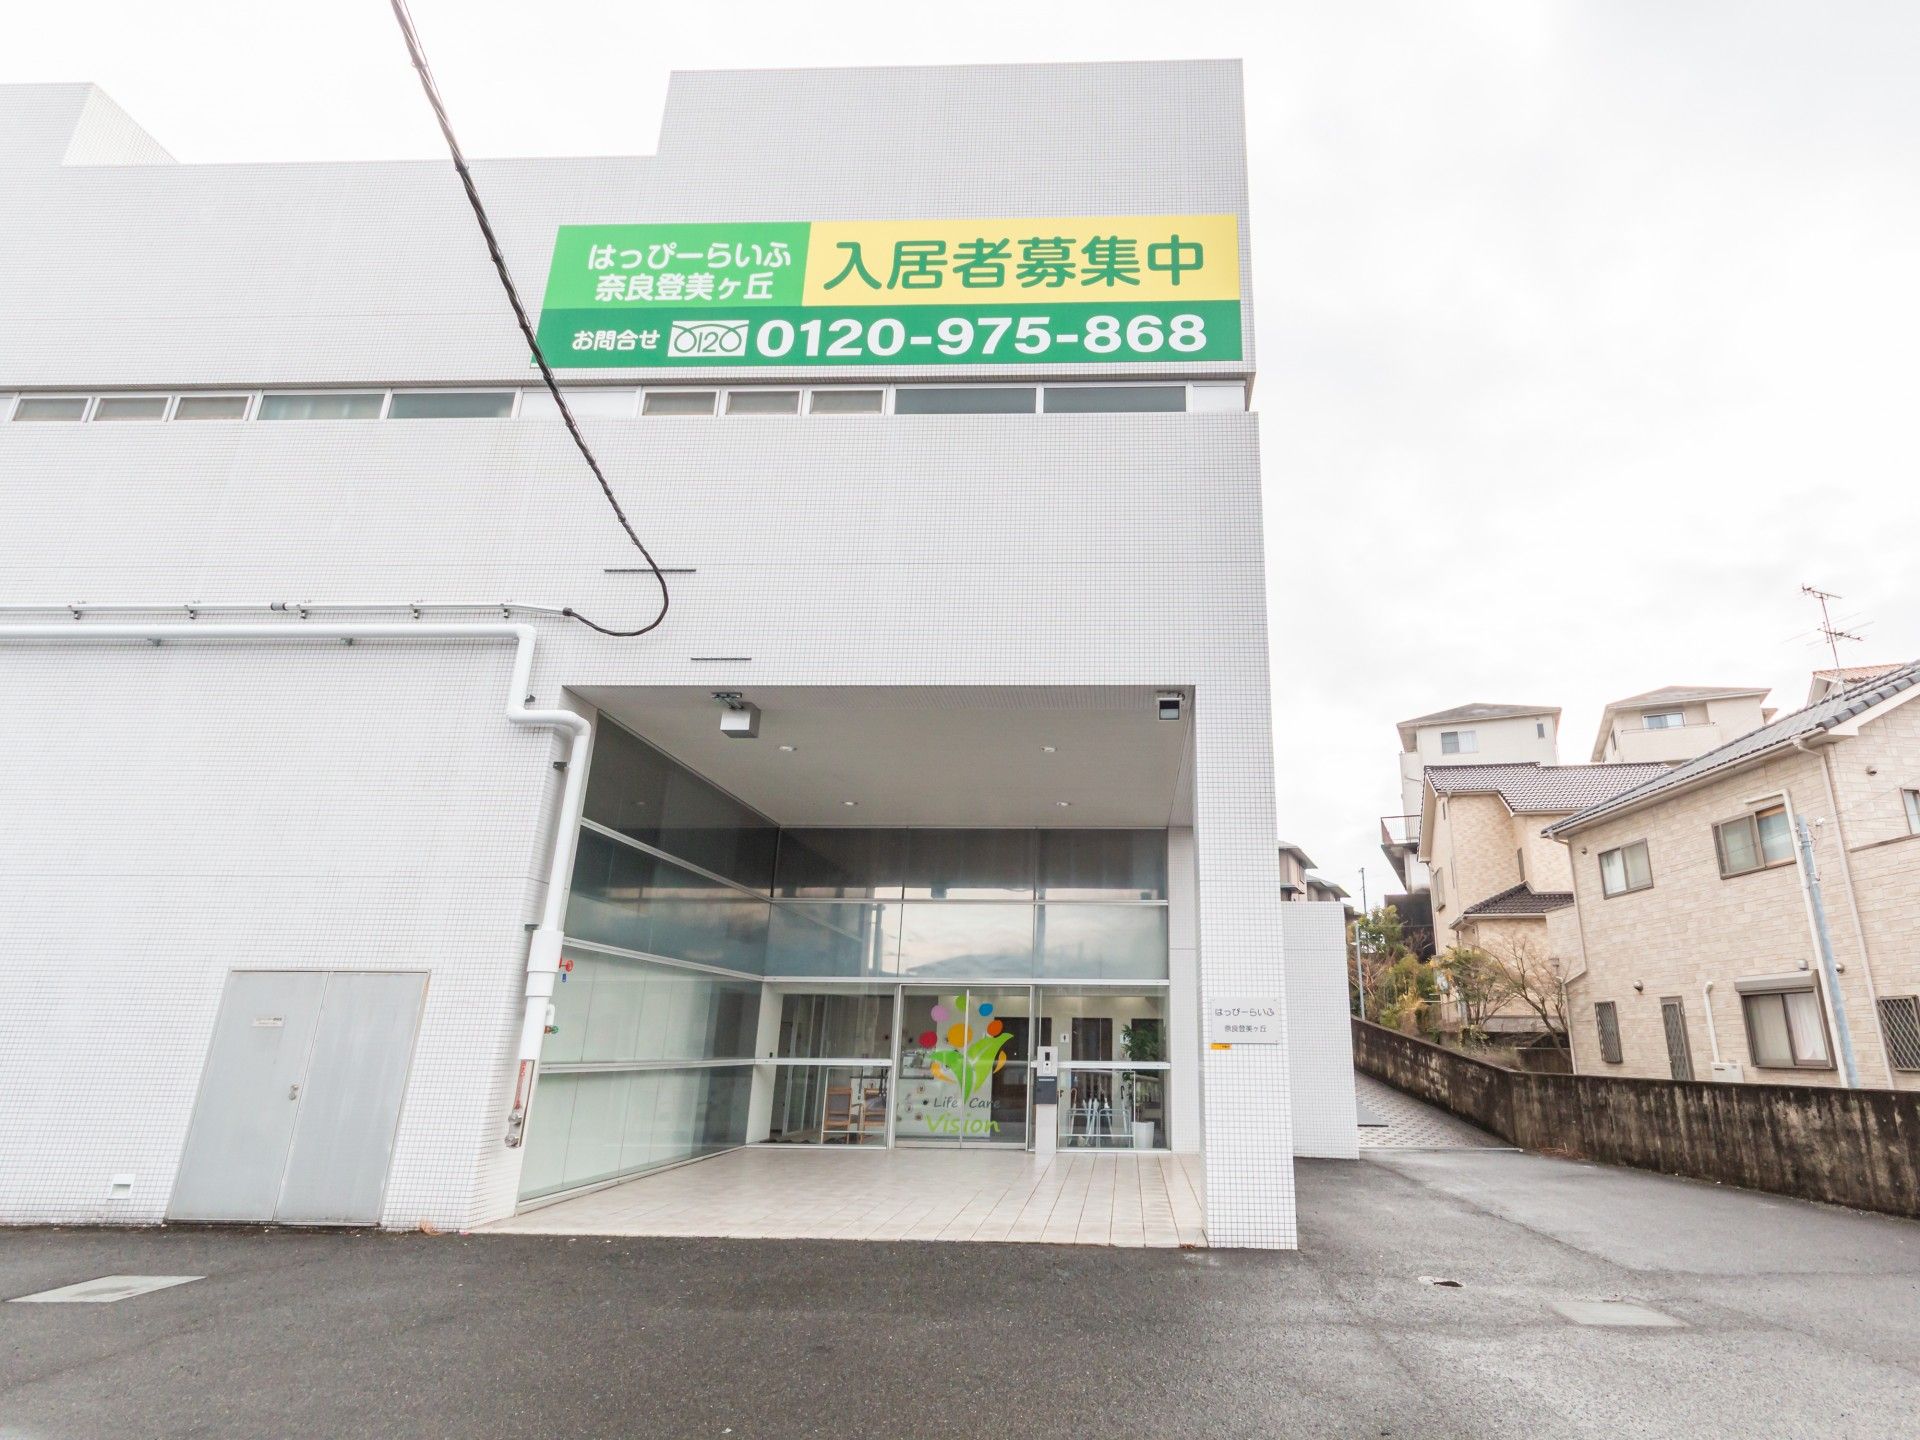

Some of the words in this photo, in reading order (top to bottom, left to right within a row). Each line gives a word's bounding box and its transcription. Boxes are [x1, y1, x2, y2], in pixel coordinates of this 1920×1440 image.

[588, 241, 791, 270] はっぴーらいふ
[823, 234, 1204, 291] 入居者募集中
[595, 272, 773, 302] 奈良登美ヶ丘
[571, 329, 661, 351] お問合せ
[756, 314, 1208, 358] 0120-975-868
[1214, 1007, 1275, 1017] はっぴーらいふ
[933, 1096, 959, 1109] Life
[968, 1097, 1001, 1109] Care
[925, 1111, 1001, 1134] Vision
